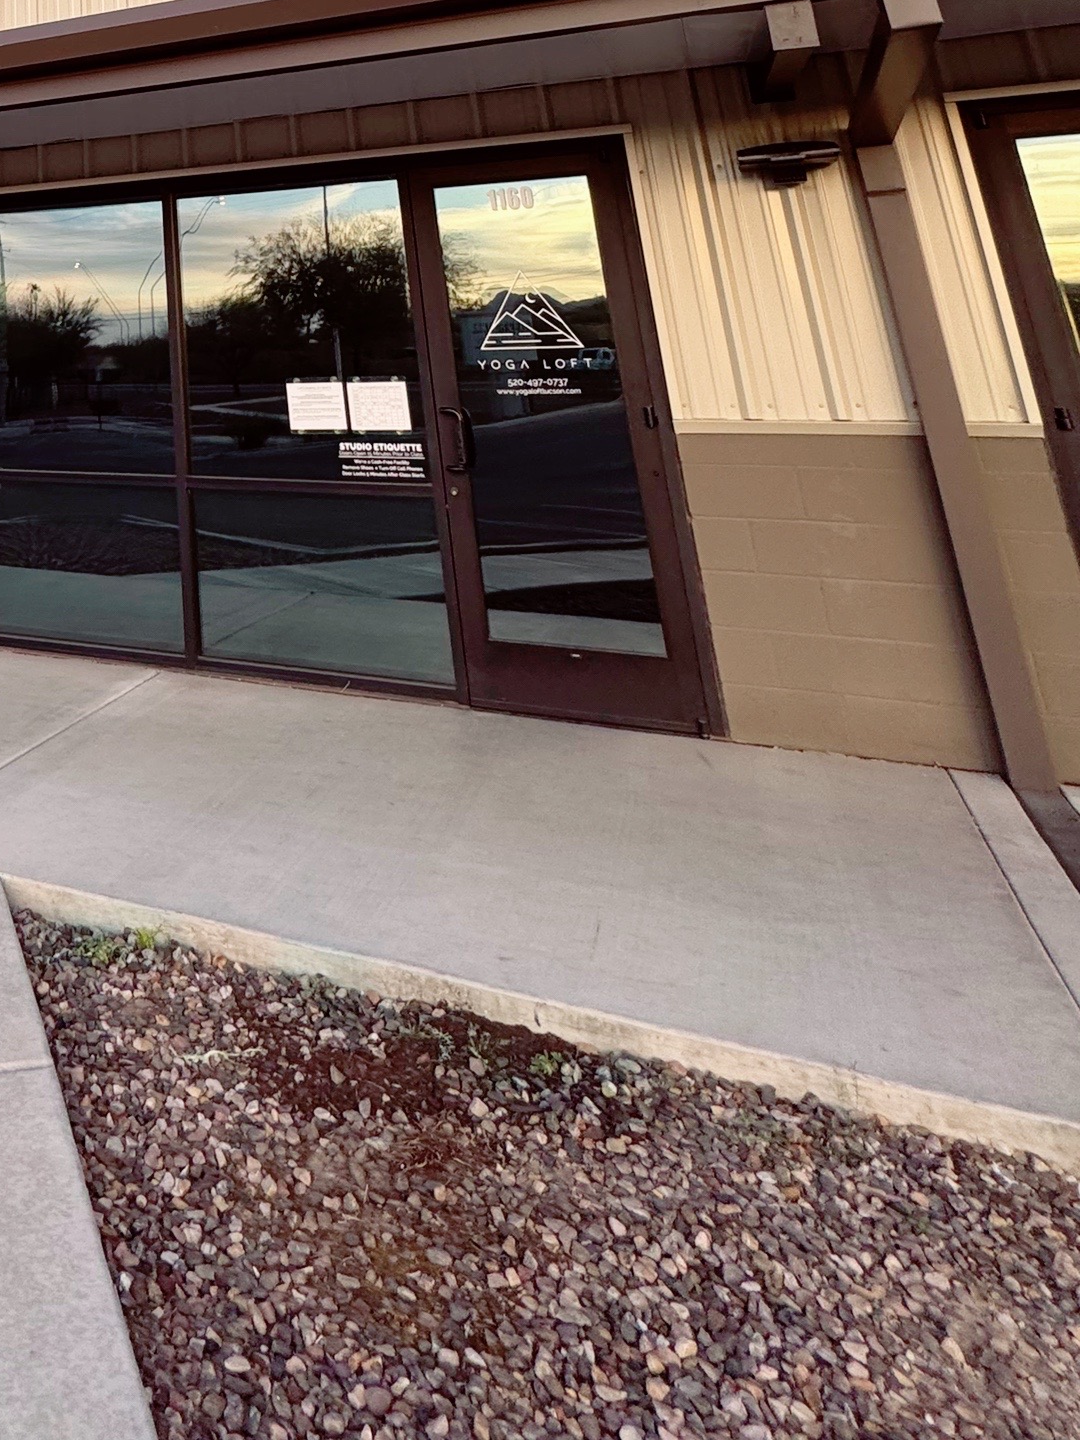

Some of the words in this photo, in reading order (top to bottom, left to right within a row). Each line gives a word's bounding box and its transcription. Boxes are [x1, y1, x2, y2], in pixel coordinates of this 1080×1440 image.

[486, 185, 534, 211] 1160
[477, 358, 530, 371] YOGA
[542, 357, 592, 370] LOFT
[507, 378, 568, 388] 520-497-0737
[339, 442, 372, 451] STUDIO
[373, 443, 422, 452] ETIQUETTE
